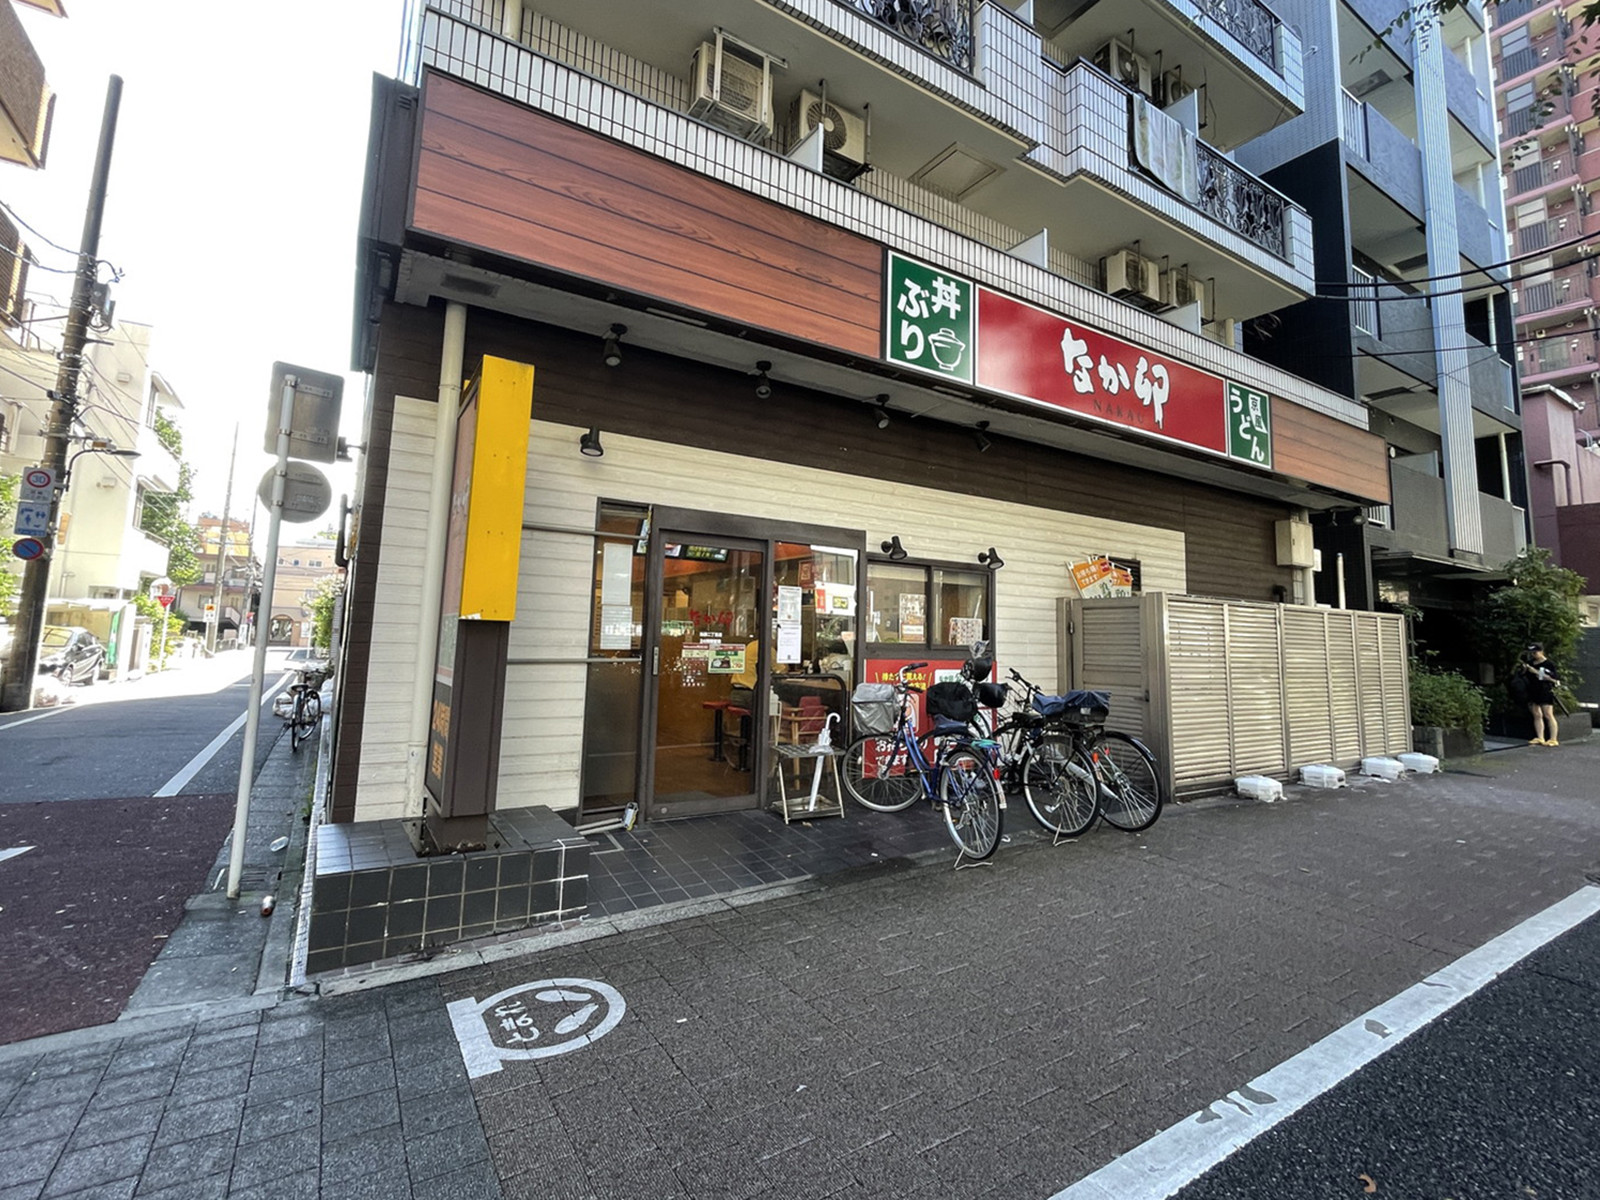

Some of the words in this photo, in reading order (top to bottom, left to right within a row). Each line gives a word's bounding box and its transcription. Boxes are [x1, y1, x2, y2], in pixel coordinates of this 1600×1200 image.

[897, 278, 931, 361] ぶり
[931, 277, 961, 321] 丼
[1060, 327, 1170, 430] なか卯
[1093, 399, 1144, 424] NAKAU
[1229, 387, 1265, 462] うどん
[31, 475, 46, 484] 30
